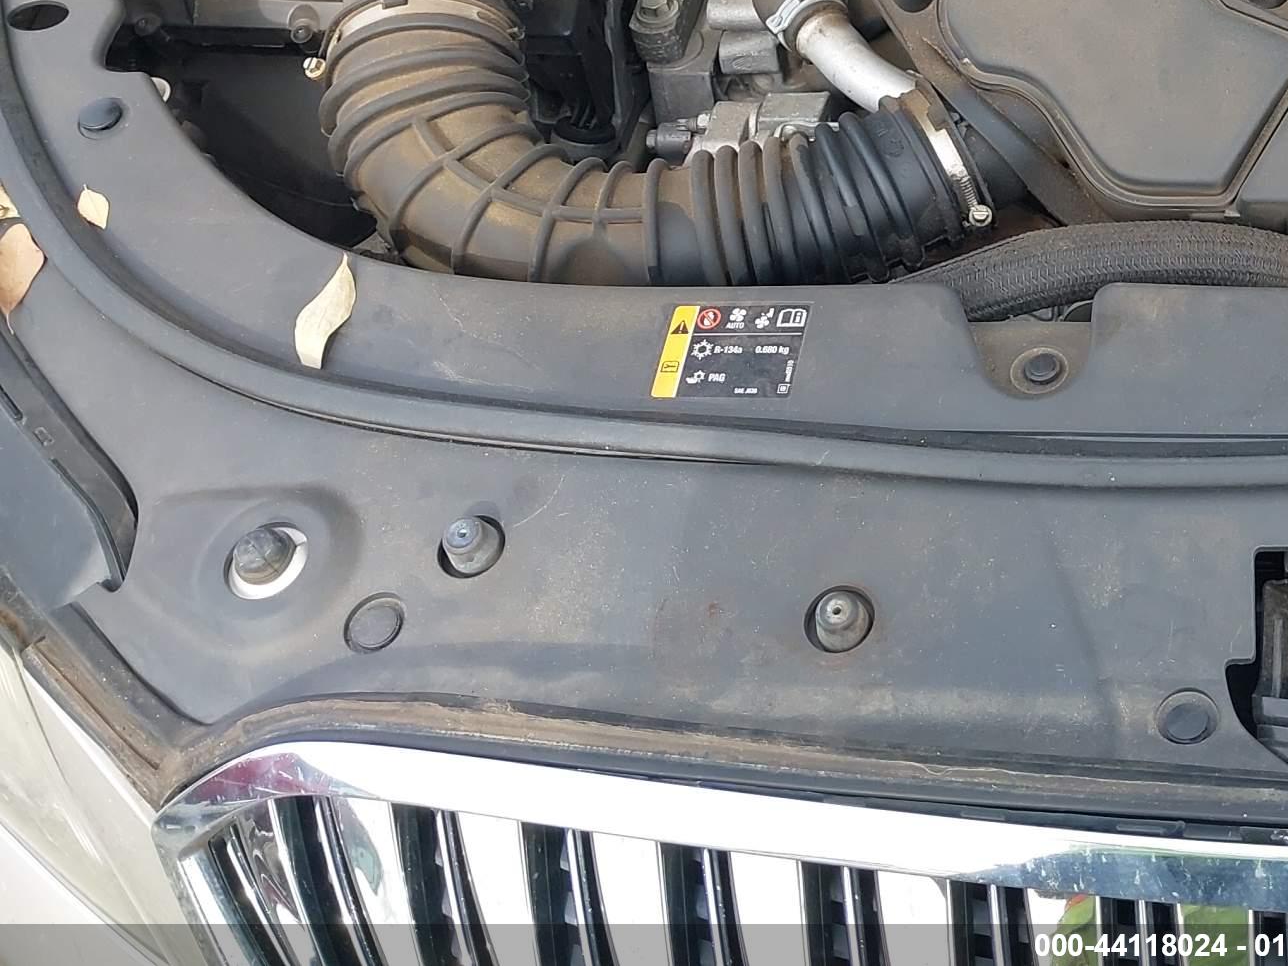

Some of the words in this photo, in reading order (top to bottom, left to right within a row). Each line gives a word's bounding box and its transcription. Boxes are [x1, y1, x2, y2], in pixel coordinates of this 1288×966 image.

[713, 345, 743, 354] R-134a
[779, 345, 790, 355] kg
[708, 373, 726, 382] PAG
